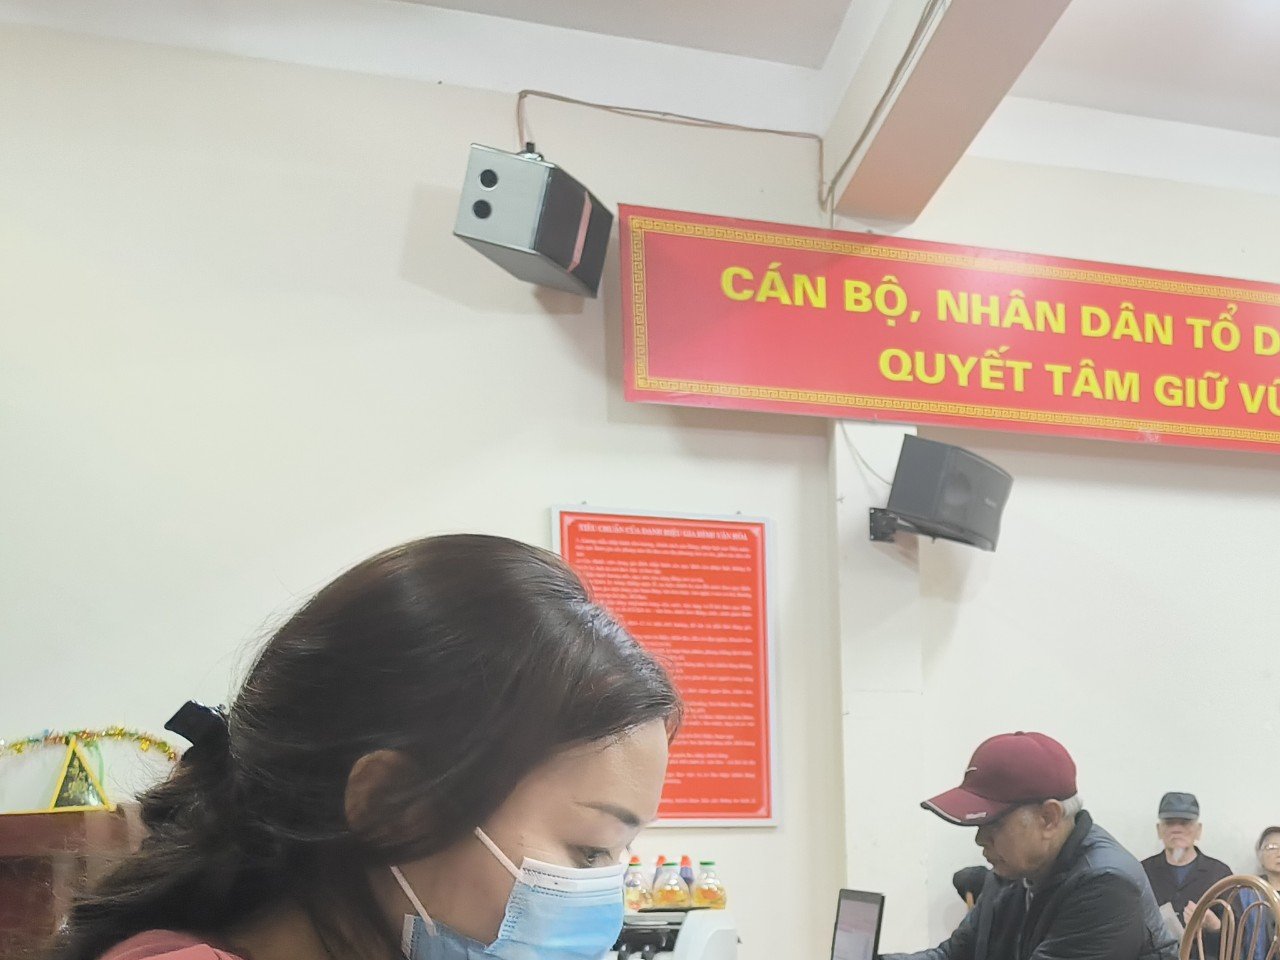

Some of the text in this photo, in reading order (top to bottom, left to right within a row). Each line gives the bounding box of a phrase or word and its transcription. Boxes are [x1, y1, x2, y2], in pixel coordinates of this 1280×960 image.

[720, 261, 828, 309] CÁN
[843, 274, 921, 327] BỘ,
[935, 289, 1066, 335] NHÂN
[1080, 301, 1174, 347] DÂN
[1185, 303, 1242, 352] TỔ
[878, 345, 1033, 393] QUYẾT
[1044, 357, 1140, 403] TÂM
[1153, 370, 1230, 411] GIỮ
